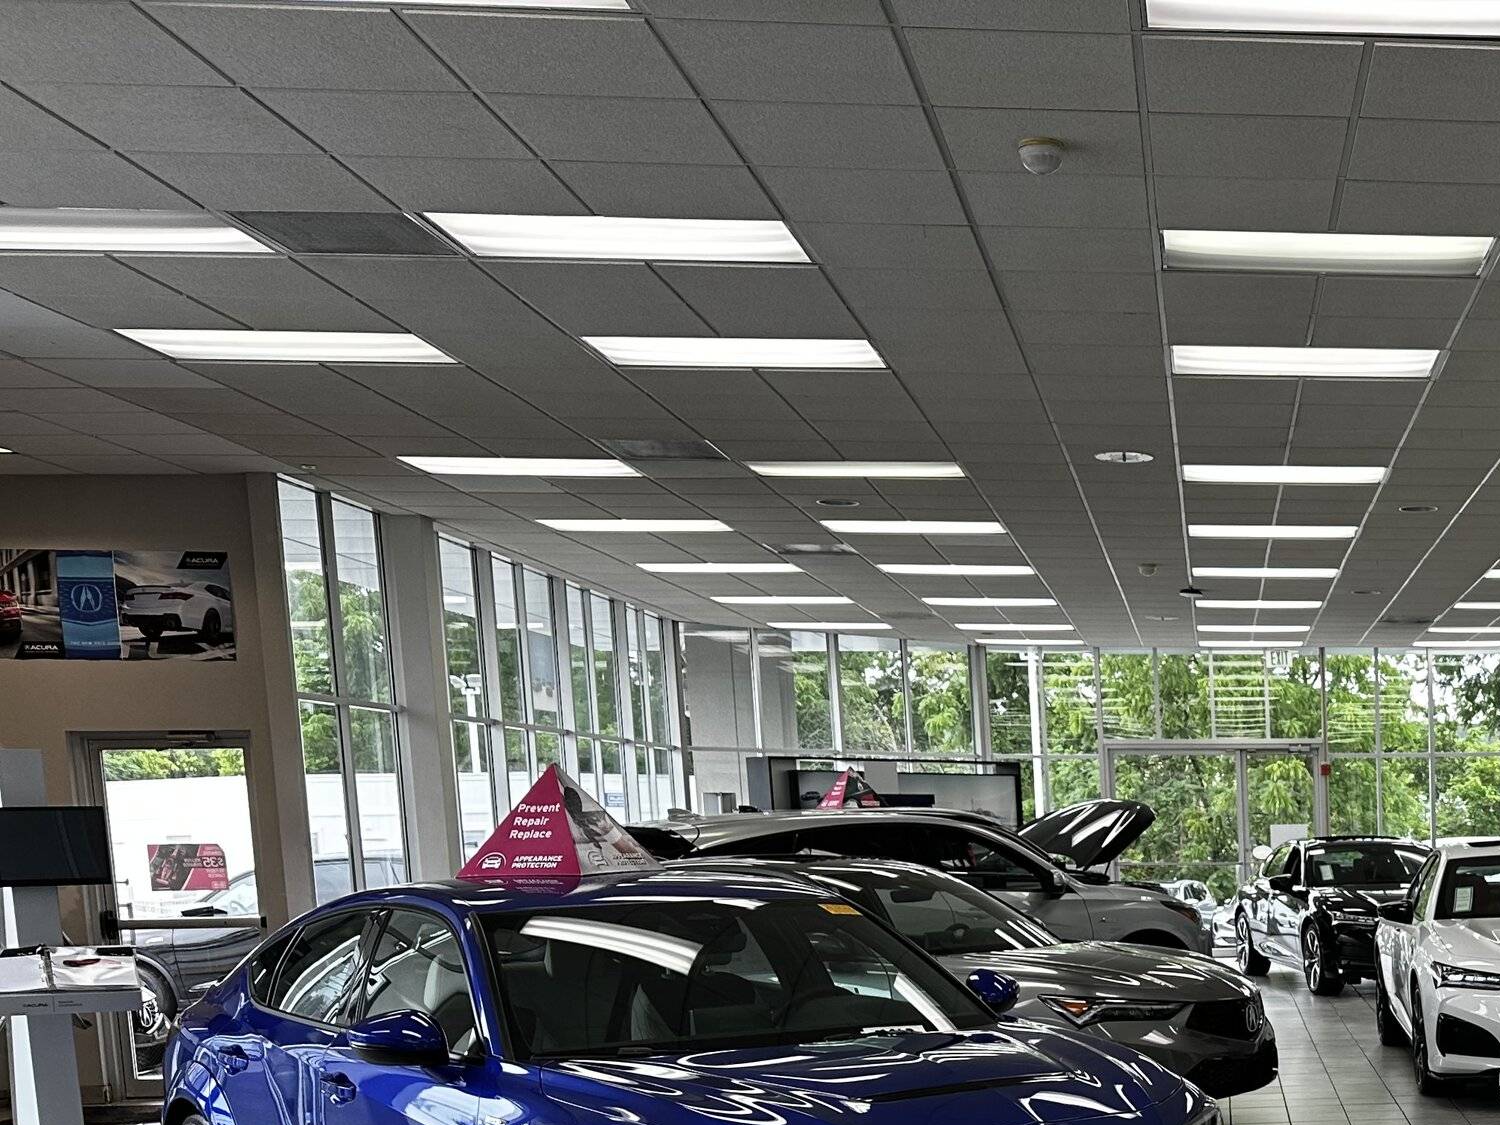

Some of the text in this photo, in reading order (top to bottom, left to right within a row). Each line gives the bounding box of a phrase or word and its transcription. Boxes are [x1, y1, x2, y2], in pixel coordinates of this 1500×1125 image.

[517, 802, 561, 813] Prevent
[513, 816, 549, 828] Repair
[509, 829, 552, 840] Replace
[511, 861, 558, 869] PROTECTION
